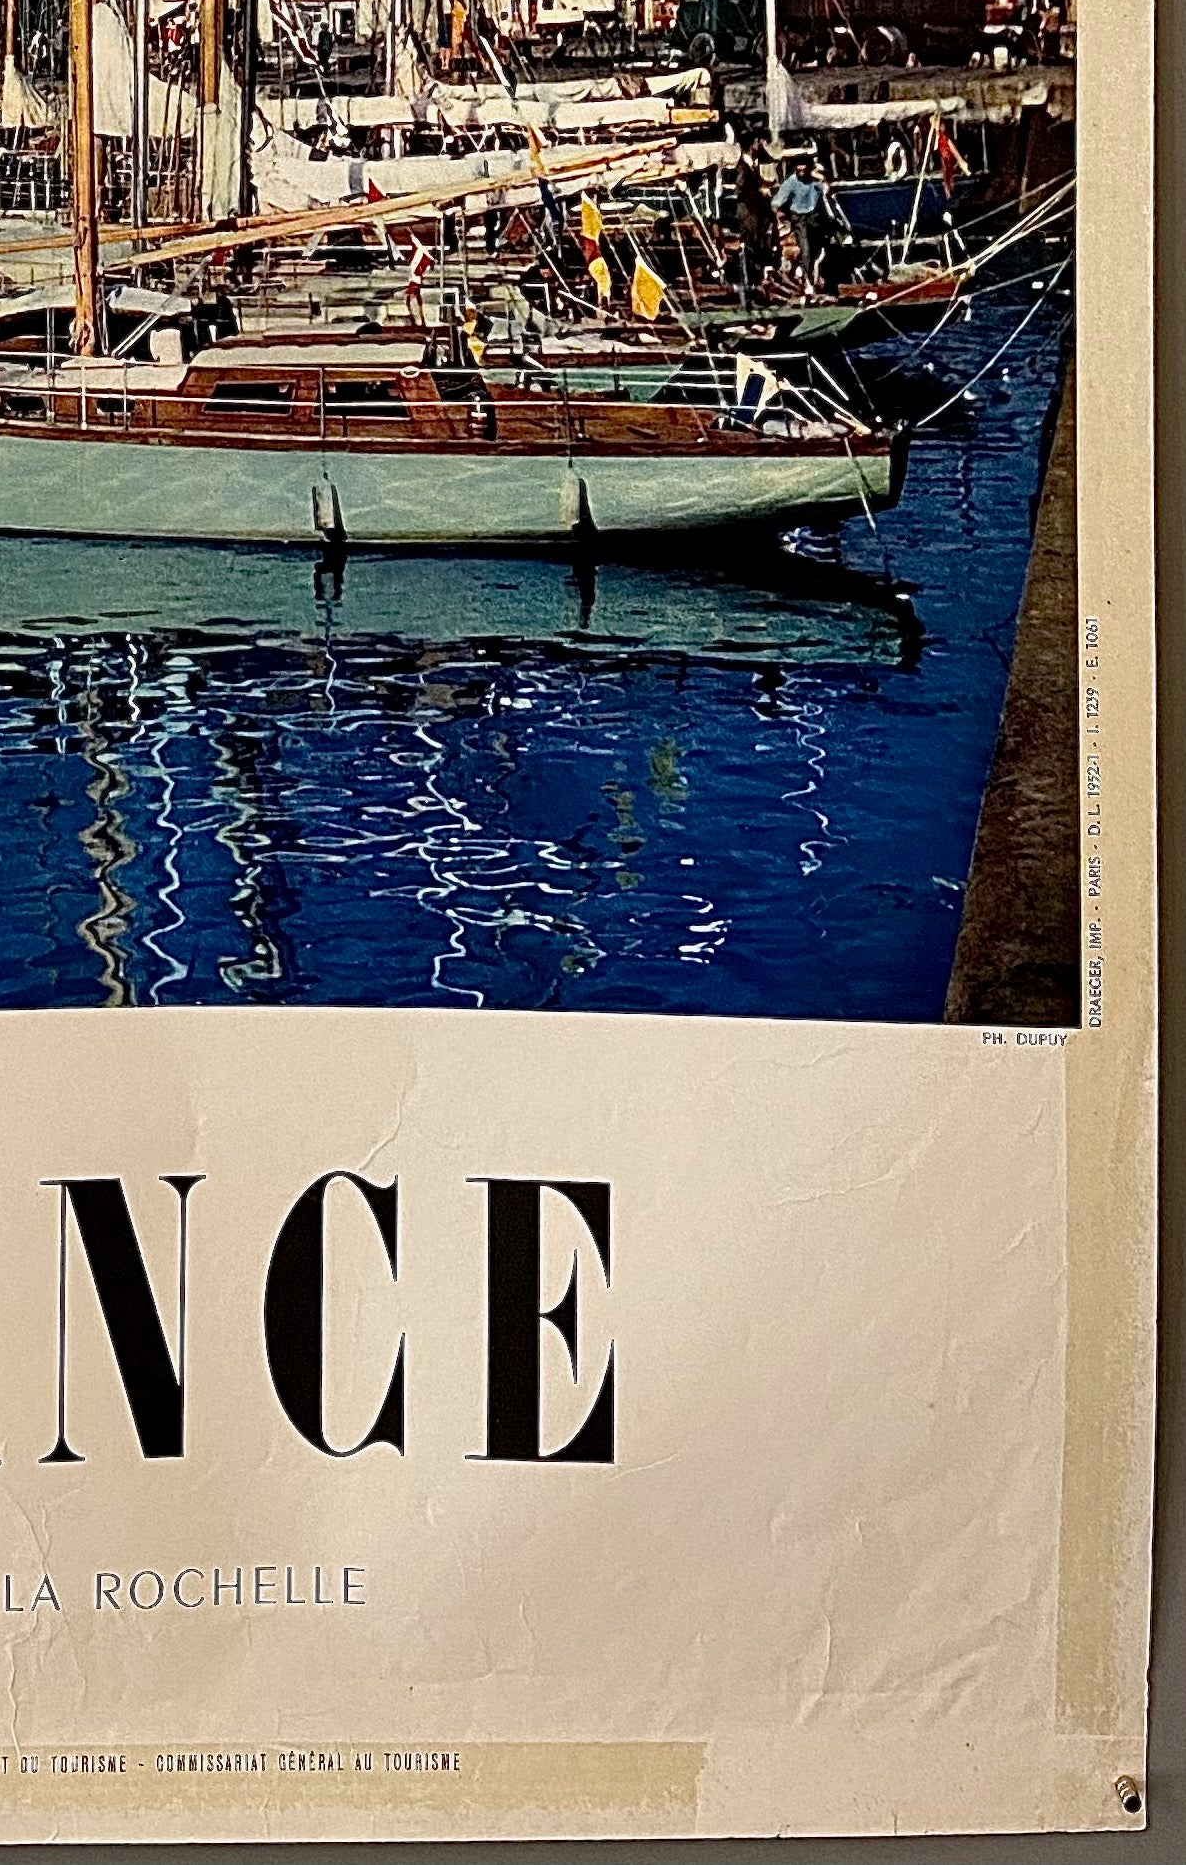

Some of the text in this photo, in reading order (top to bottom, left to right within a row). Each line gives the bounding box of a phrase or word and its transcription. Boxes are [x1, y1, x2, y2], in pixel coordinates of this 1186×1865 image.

[1085, 618, 1099, 650] 1061
[1088, 856, 1101, 897] PARIS
[1088, 918, 1102, 949] IMP.
[1088, 956, 1104, 1028] DRAEGER,
[982, 1032, 1067, 1046] PH. DUPUY
[5, 1573, 61, 1612] LA
[95, 1566, 366, 1610] ROCHELLE
[20, 1756, 39, 1775] DU
[51, 1754, 127, 1773] TOURISME
[156, 1753, 266, 1772] COMMISSARIAT
[278, 1750, 344, 1771] GÉNÉRAL
[354, 1752, 372, 1771] AU
[384, 1751, 460, 1772] TOURISME
